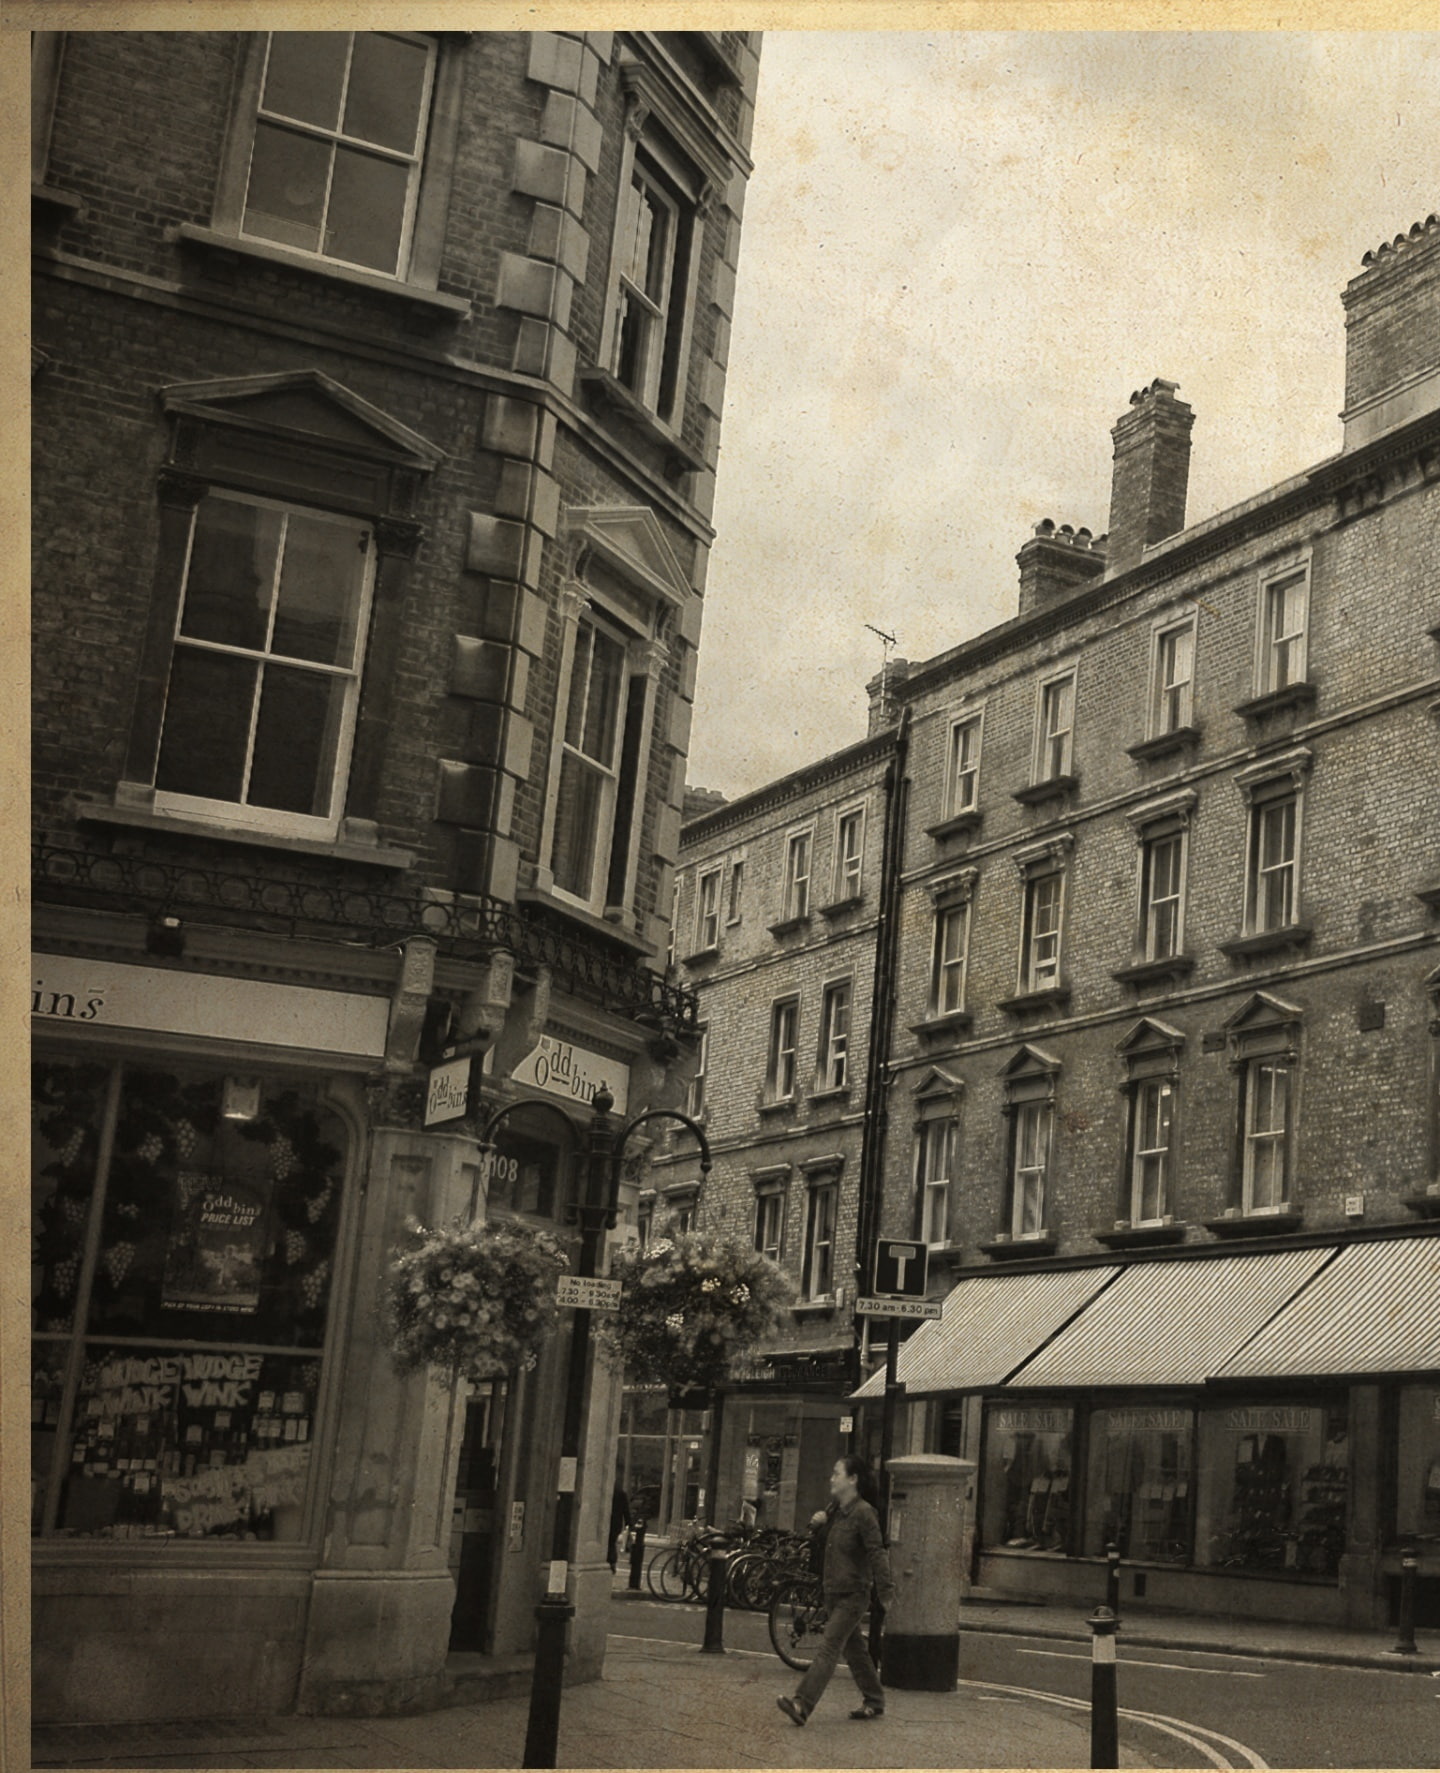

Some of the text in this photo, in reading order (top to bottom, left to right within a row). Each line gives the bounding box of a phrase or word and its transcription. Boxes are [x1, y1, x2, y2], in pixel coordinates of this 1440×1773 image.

[535, 1043, 604, 1102] Oddbin
[490, 1155, 519, 1182] 108
[203, 1195, 262, 1216] Oddbins
[200, 1213, 256, 1226] PRICE LIST
[859, 1301, 880, 1310] 7.30
[883, 1304, 896, 1312] am
[901, 1304, 923, 1314] 6.30
[924, 1307, 938, 1315] pm
[181, 1354, 264, 1381] NUDGE
[182, 1381, 251, 1407] WINK
[1000, 1411, 1027, 1428] SALE
[1108, 1410, 1181, 1428] SALE SALE
[1230, 1409, 1309, 1428] SALE SALE
